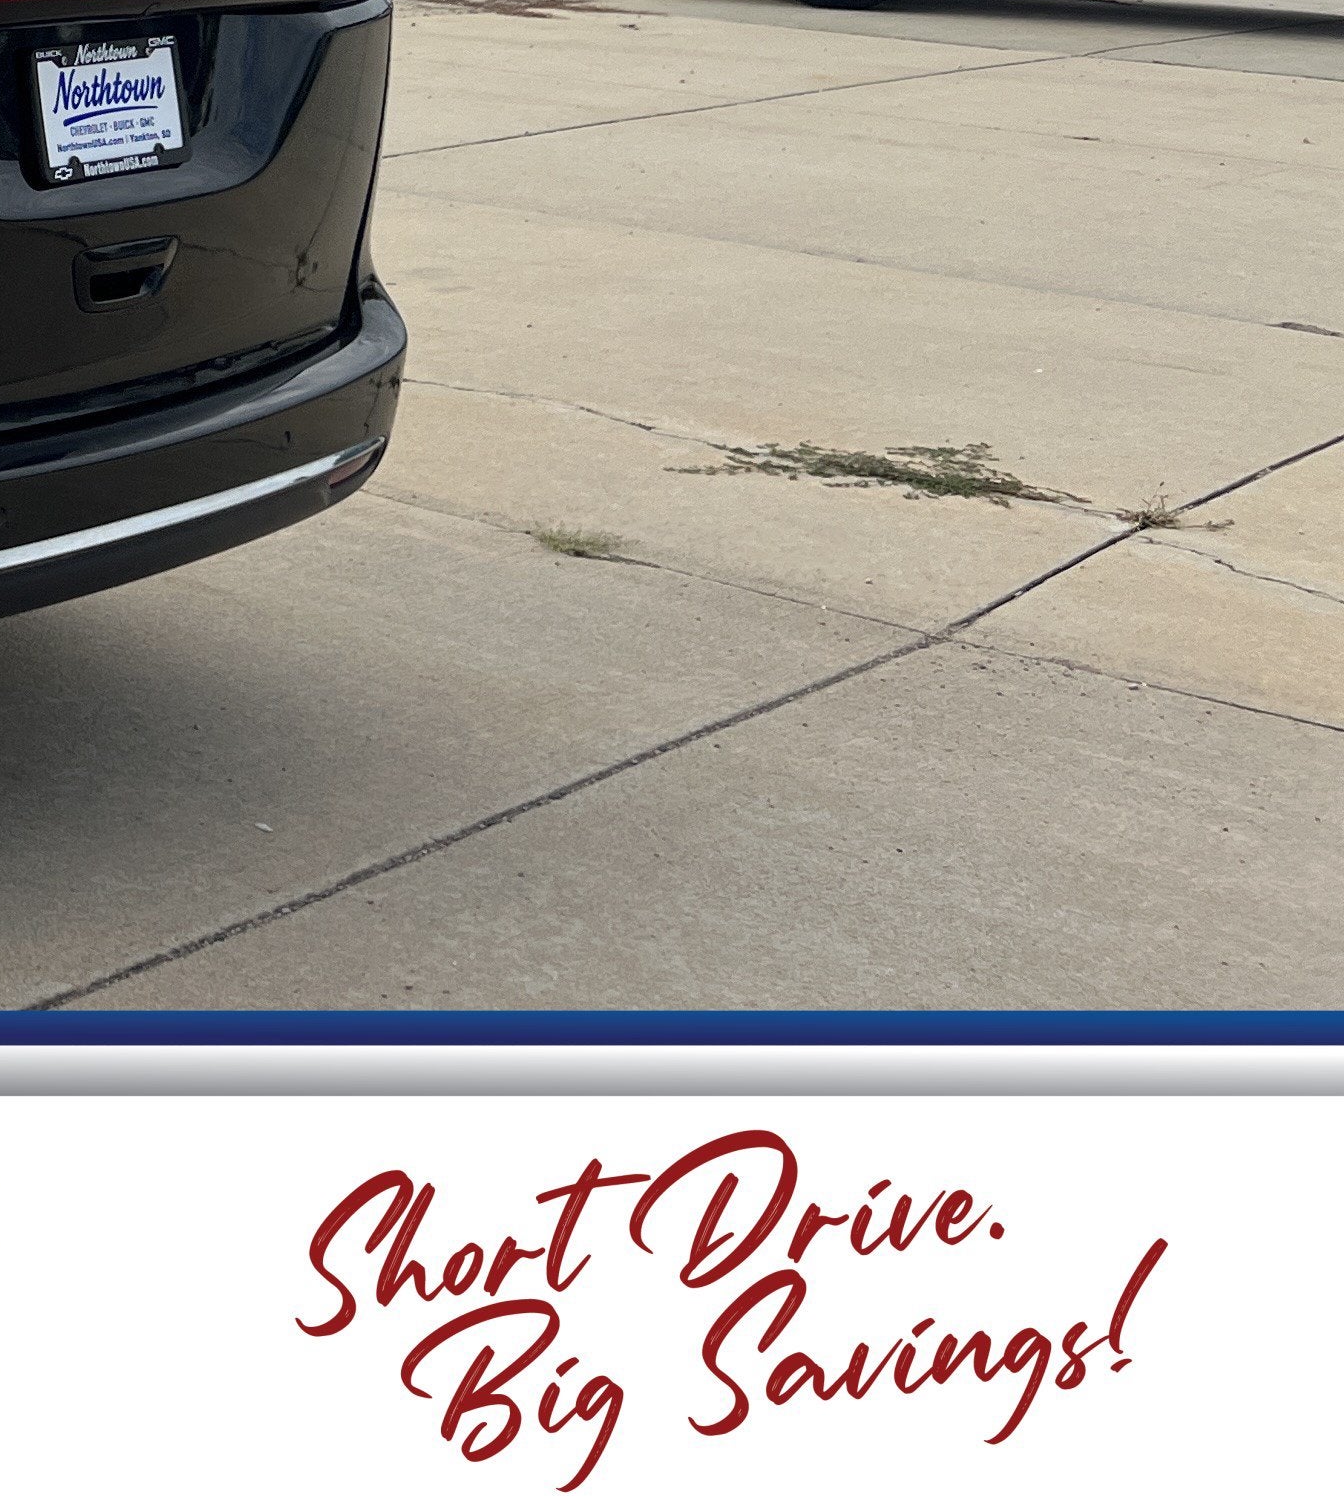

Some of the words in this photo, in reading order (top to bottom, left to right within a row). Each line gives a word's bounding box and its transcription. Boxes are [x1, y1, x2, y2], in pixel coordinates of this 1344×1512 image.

[148, 36, 175, 47] GMC
[73, 42, 138, 66] Northtown
[52, 68, 165, 115] Northtown
[70, 121, 108, 137] CHEVROLET
[113, 118, 135, 131] BUICK
[140, 115, 155, 128] GMC
[83, 154, 160, 177] NorthtownUSA.com
